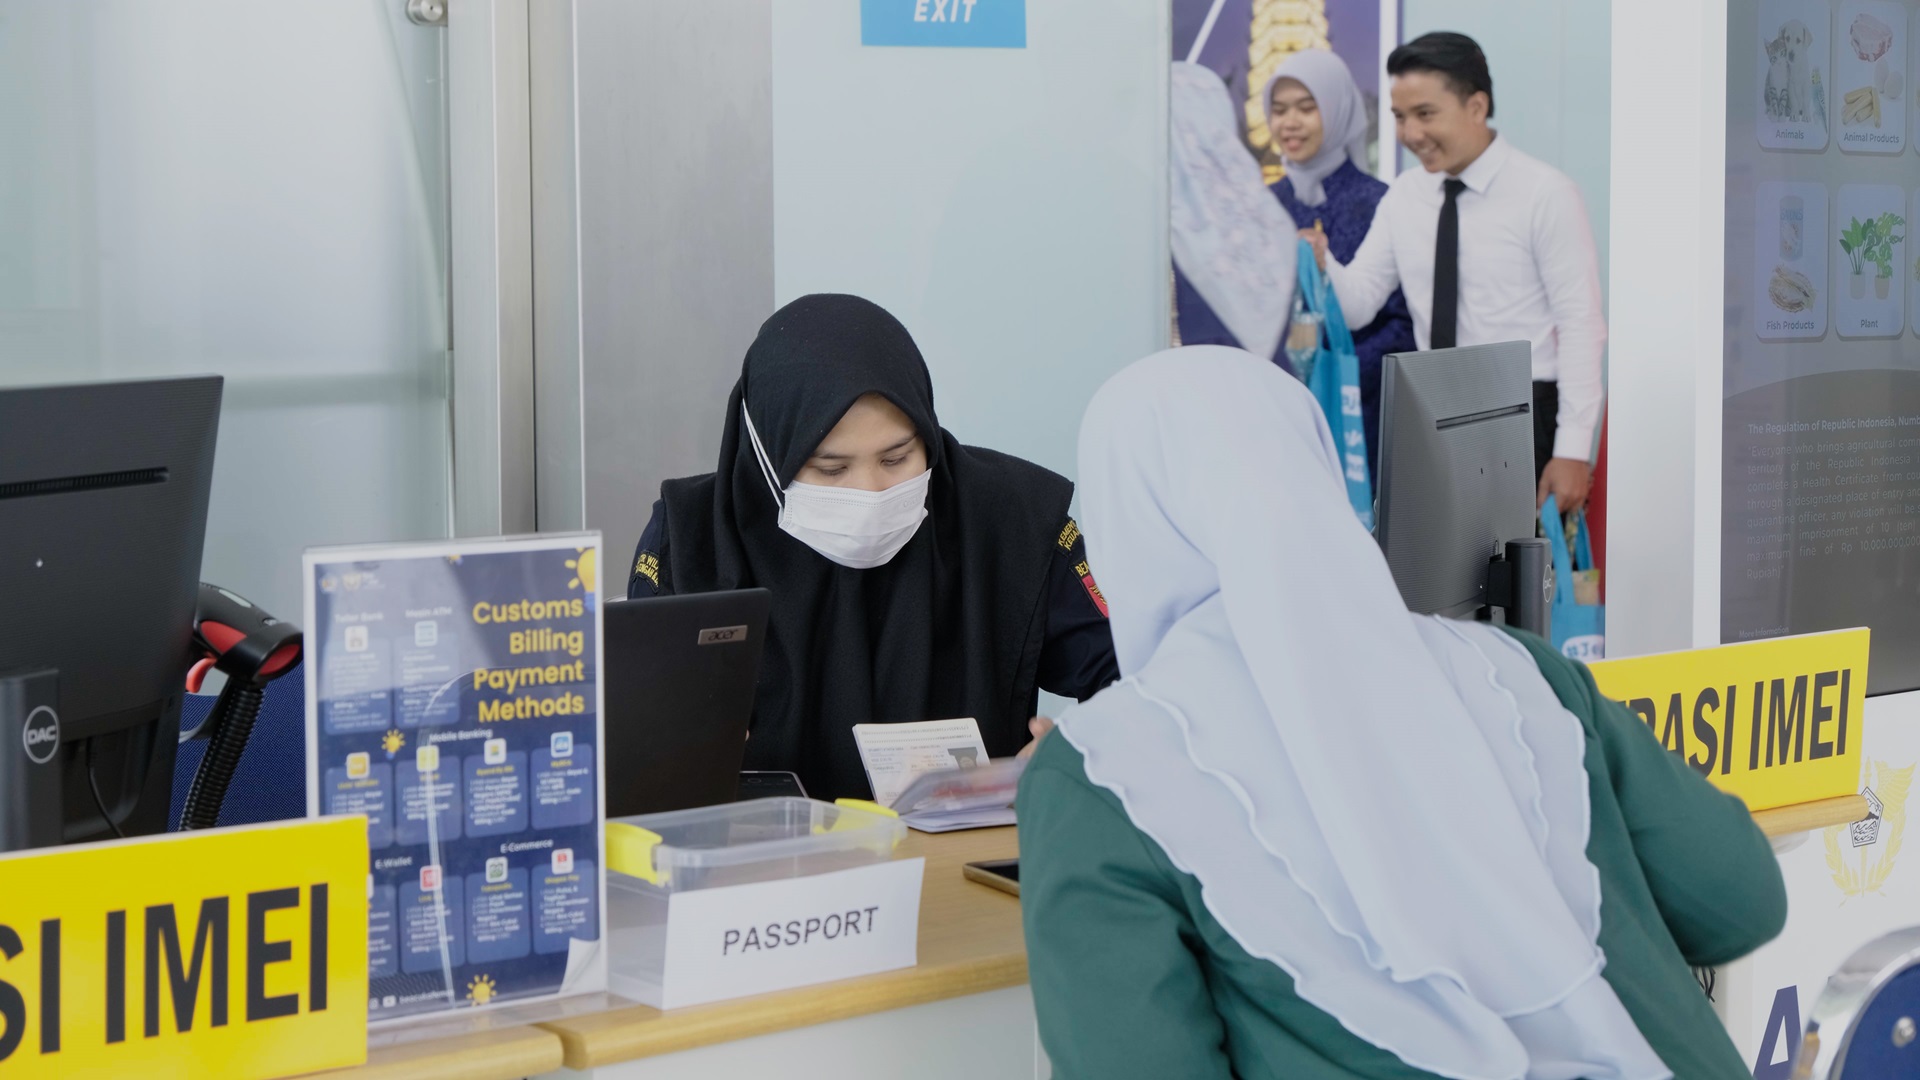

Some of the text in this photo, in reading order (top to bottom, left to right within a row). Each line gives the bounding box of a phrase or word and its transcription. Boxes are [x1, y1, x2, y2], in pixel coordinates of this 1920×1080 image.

[913, 0, 977, 23] EXIT
[1775, 129, 1805, 140] Animals
[1843, 132, 1900, 144] Animal Products
[1766, 320, 1815, 331] Fish Products
[1860, 319, 1879, 329] Plant
[1748, 423, 1764, 434] The
[1765, 420, 1810, 436] Regulation
[1811, 420, 1820, 431] of
[1821, 418, 1856, 432] Republic
[1857, 415, 1897, 429] Indonesia,
[1795, 442, 1814, 454] who
[1817, 441, 1845, 455] brings
[1847, 437, 1896, 453] agricultural
[1747, 462, 1784, 476] territory
[1790, 460, 1800, 472] of
[1806, 459, 1821, 471] the
[1827, 456, 1865, 471] Republic
[1871, 454, 1911, 467] Indonesia
[1747, 479, 1789, 493] complete
[1793, 480, 1799, 490] a
[1802, 475, 1831, 489] Health
[1834, 472, 1879, 487] Certificate
[1882, 471, 1903, 483] from
[1747, 499, 1783, 511] through
[1786, 497, 1792, 507] a
[1795, 491, 1843, 506] designated
[1845, 490, 1869, 504] place
[1871, 488, 1880, 499] of
[1882, 488, 1904, 502] entry
[1746, 514, 1795, 529] quarantine
[1831, 511, 1847, 522] any
[1849, 506, 1885, 519] violation
[1888, 504, 1902, 516] will
[1904, 503, 1915, 514] be
[1746, 519, 1916, 545] maximum imprisonment of 10 (ten)
[1746, 549, 1791, 562] maximum
[1799, 545, 1817, 557] fine
[1824, 543, 1834, 555] of
[1841, 542, 1853, 555] Rp
[472, 599, 584, 624] Customs
[509, 627, 584, 656] Billing
[708, 629, 739, 641] acer
[1739, 625, 1790, 640] More Information
[473, 659, 585, 695] Payment
[478, 691, 585, 723] Methods
[1749, 668, 1851, 771] IMEI
[28, 725, 57, 745] DAC
[429, 728, 493, 742] Mobile Banking
[500, 838, 554, 854] E-Commerce
[374, 856, 412, 870] E-Wallet
[722, 906, 879, 956] PASSPORT
[105, 883, 328, 1045] IMEI
